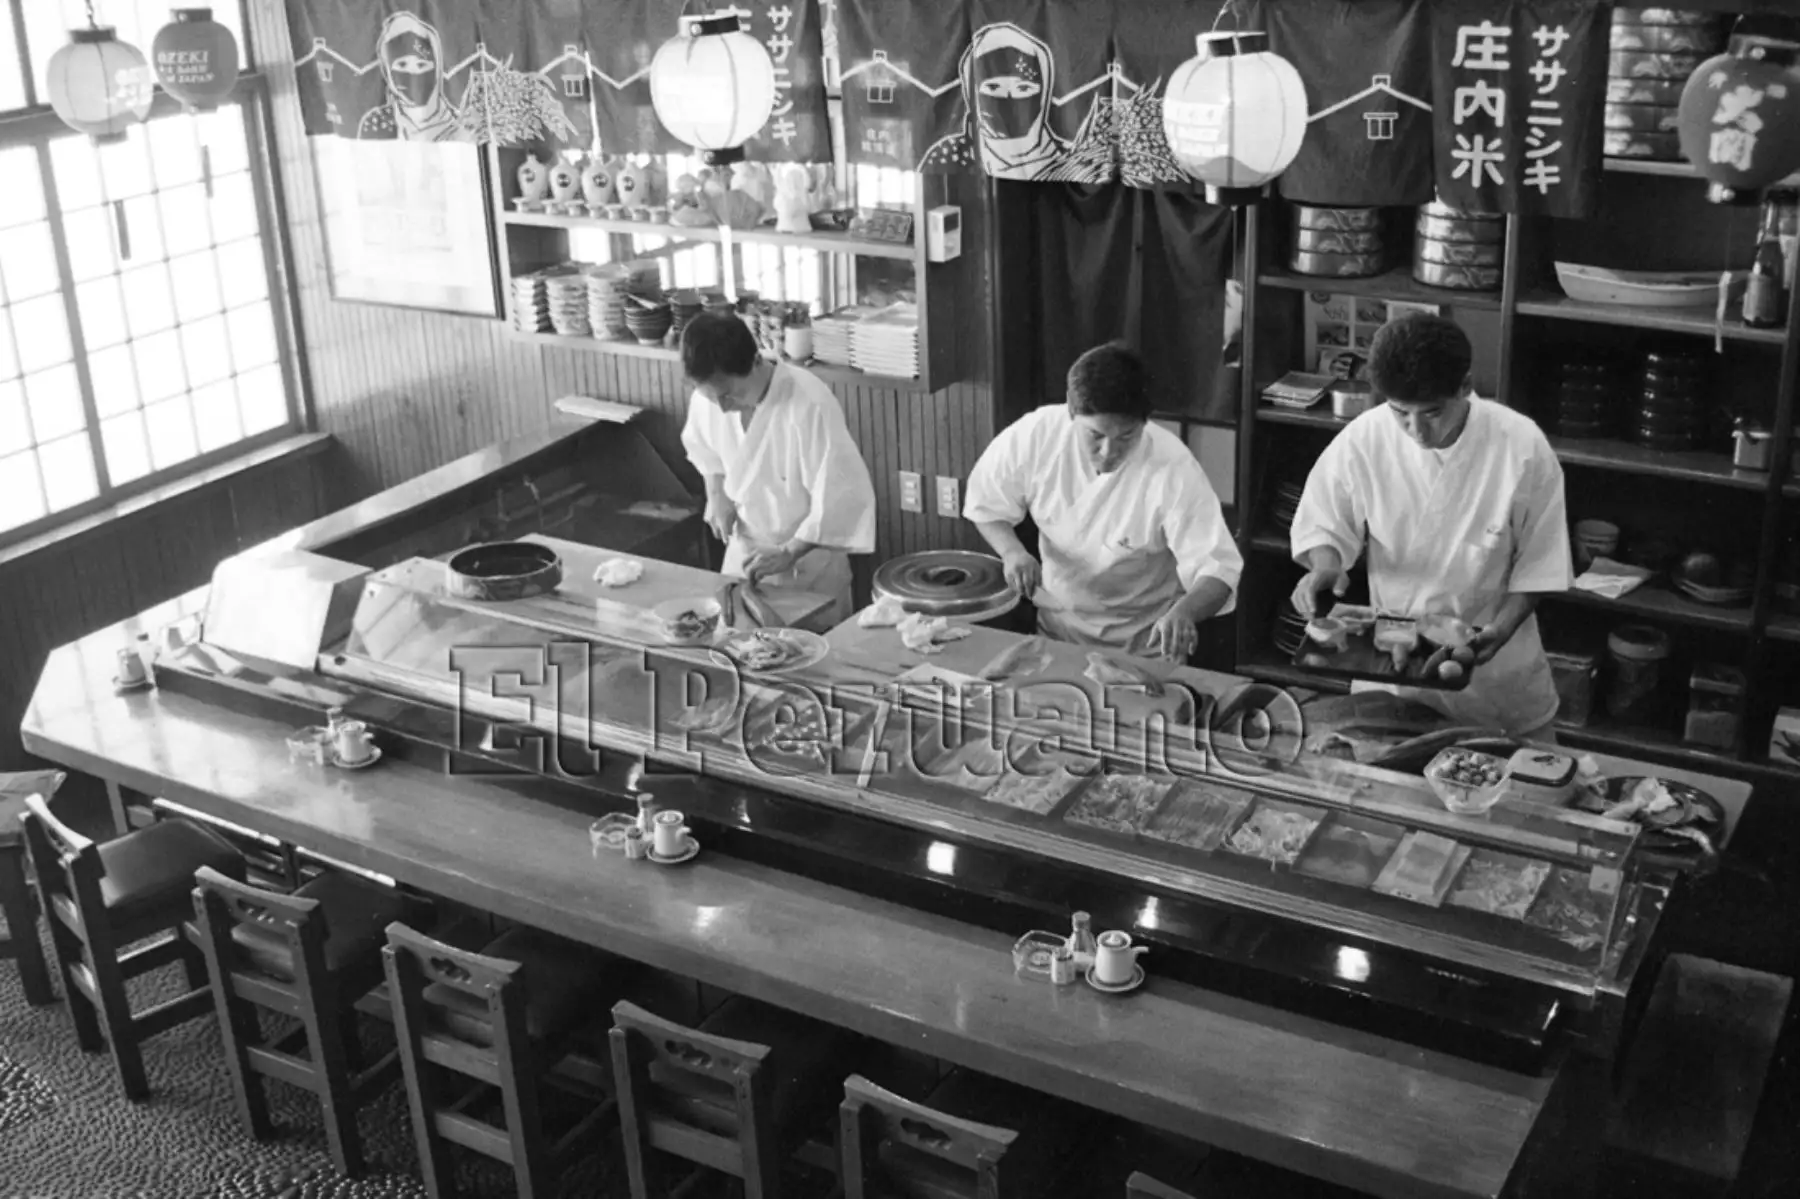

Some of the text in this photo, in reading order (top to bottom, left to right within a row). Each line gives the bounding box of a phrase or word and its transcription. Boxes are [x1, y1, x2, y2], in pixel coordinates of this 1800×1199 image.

[1451, 20, 1512, 188] 庄内米
[1523, 25, 1570, 194] ササニシキ
